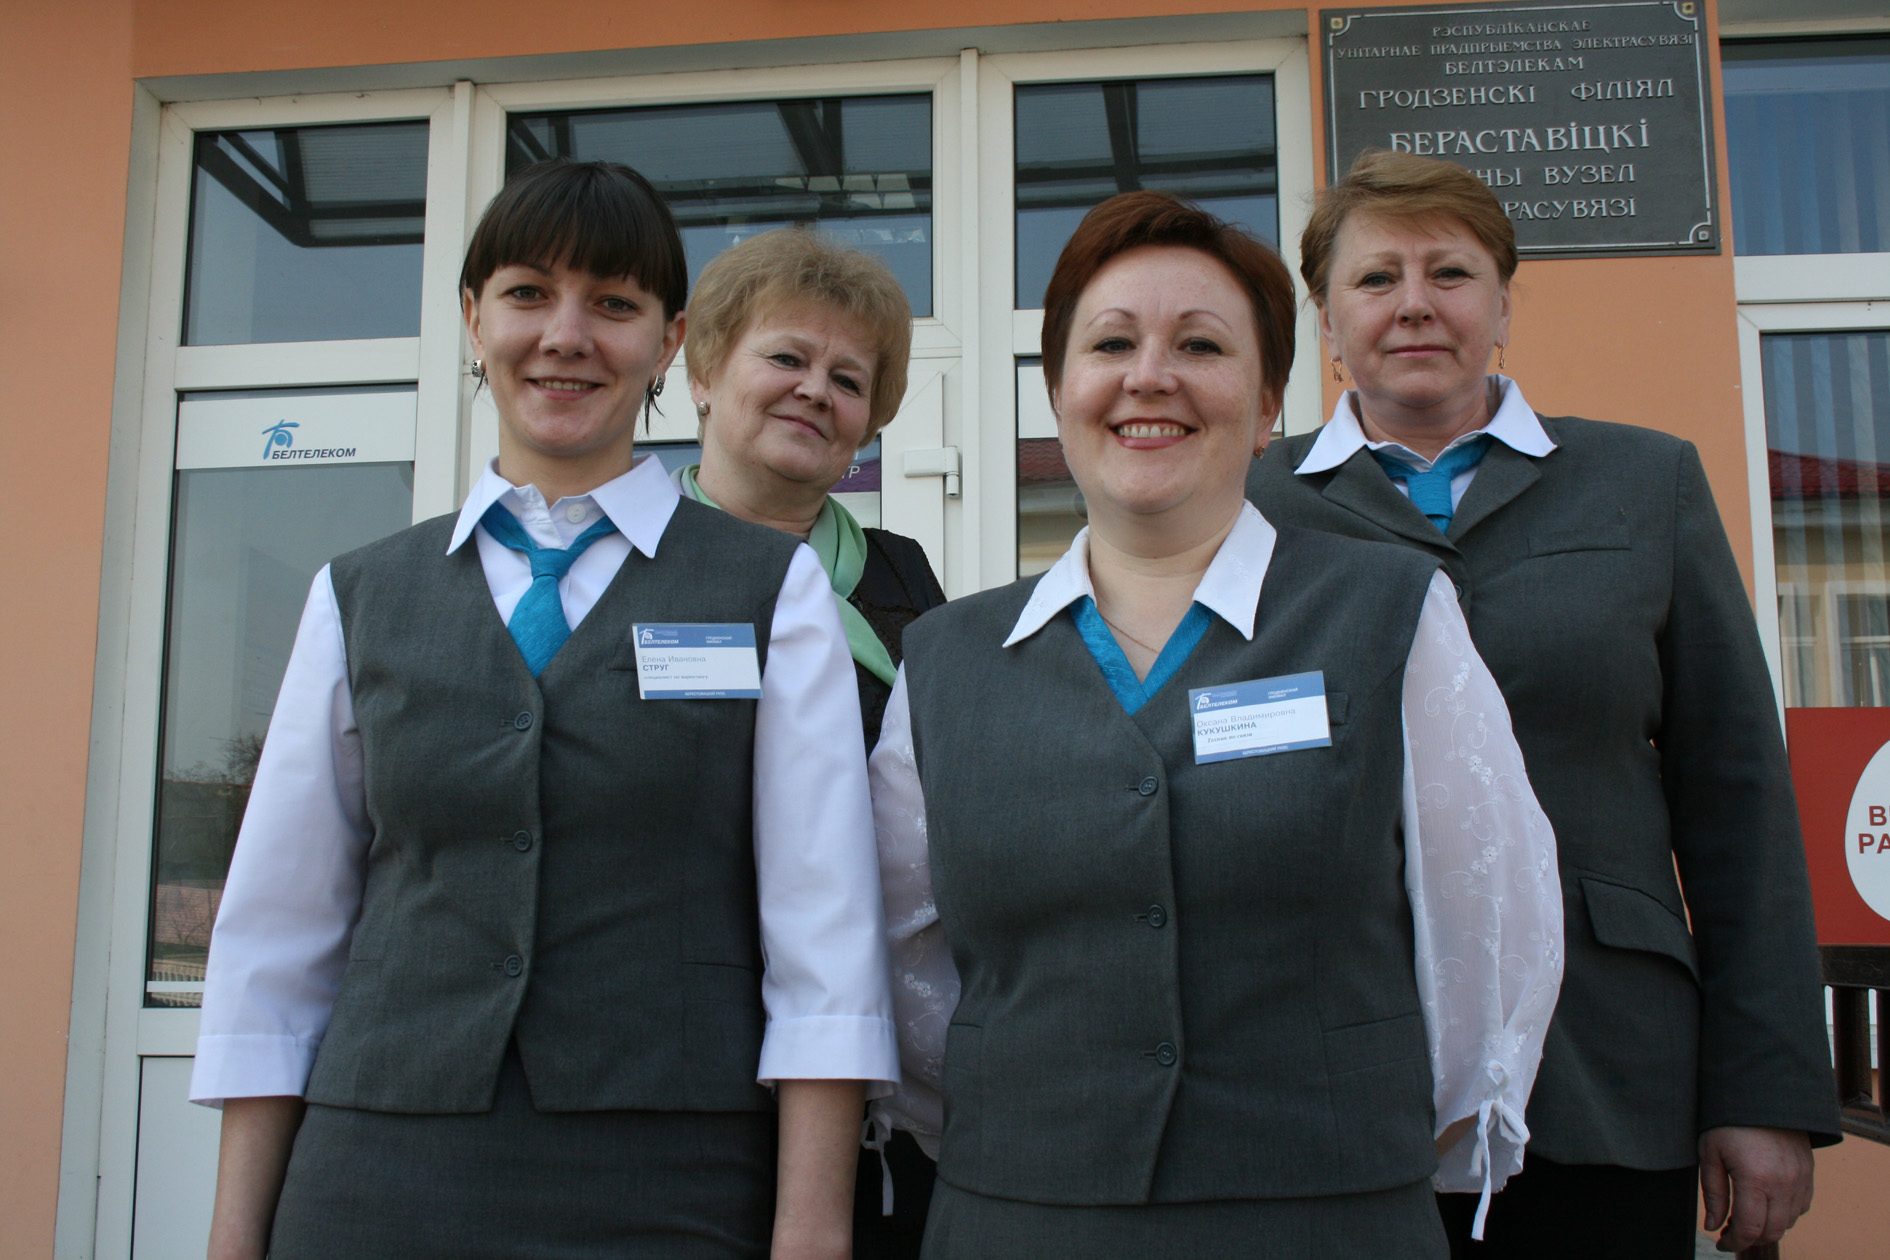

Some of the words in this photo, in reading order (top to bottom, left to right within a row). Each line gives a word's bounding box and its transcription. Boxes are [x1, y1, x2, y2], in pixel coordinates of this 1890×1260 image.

[1432, 21, 1591, 38] РЭСПУБЛІКАНСКАЕ
[1336, 45, 1421, 60] УНІТАРНАЕ
[1430, 39, 1562, 56] ПРАДПРЫЕМСТВА
[1571, 33, 1693, 50] ЭЛЕКТРАСУВЯЗІ
[1445, 56, 1584, 76] БЕЛТЭЛЕКАМ
[1359, 84, 1536, 110] ГРОДЗЕНСКІ
[1570, 78, 1675, 101] ФІЛІЯЛ
[1390, 118, 1650, 156] БЕРАСТАВІЦКІ
[1467, 167, 1522, 188] НЫ
[1544, 164, 1636, 185] ВУЗЕЛ
[1502, 197, 1636, 220] РАСУВЯЗІ
[271, 447, 357, 461] БЕЛТЕЛЕКОМ
[642, 655, 666, 663] Елена
[668, 655, 707, 663] Ивановна
[642, 664, 669, 672] СТРУГ
[1198, 698, 1238, 710] БЕЛТЕЛЕКОМ
[1196, 718, 1228, 728] Оксана
[1230, 708, 1296, 723] Владимировна
[1196, 722, 1257, 736] КУКУШКИНА
[1868, 805, 1890, 827] В
